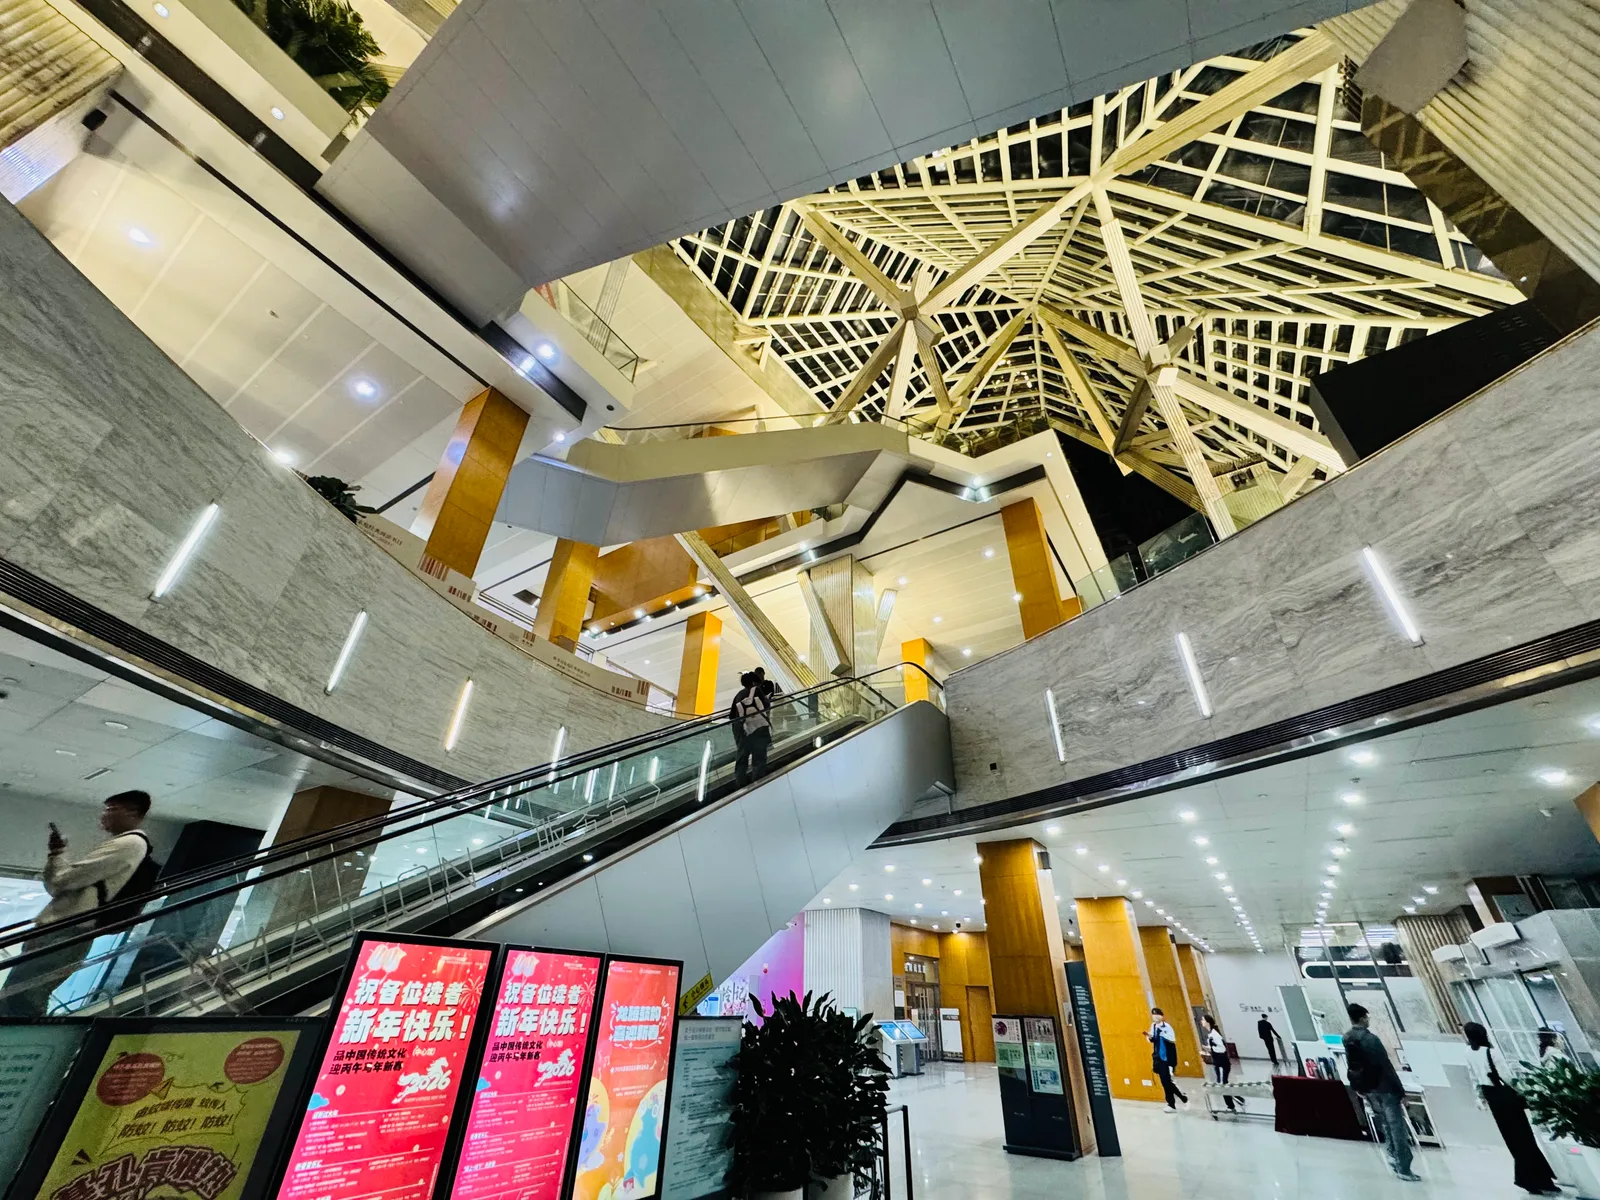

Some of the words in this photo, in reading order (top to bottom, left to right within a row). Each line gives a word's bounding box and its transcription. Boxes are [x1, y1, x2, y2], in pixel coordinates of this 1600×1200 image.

[354, 979, 465, 1007] 祝各位读者
[504, 982, 582, 1005] 祝各位读者
[332, 1047, 408, 1062] 品中国传统文化
[491, 1040, 543, 1052] 品中国传统文化
[489, 1051, 541, 1063] 迎丙午马年新春
[328, 1060, 404, 1076] 迎丙午马年新春
[544, 1058, 575, 1078] 2026
[408, 1068, 451, 1093] 2026
